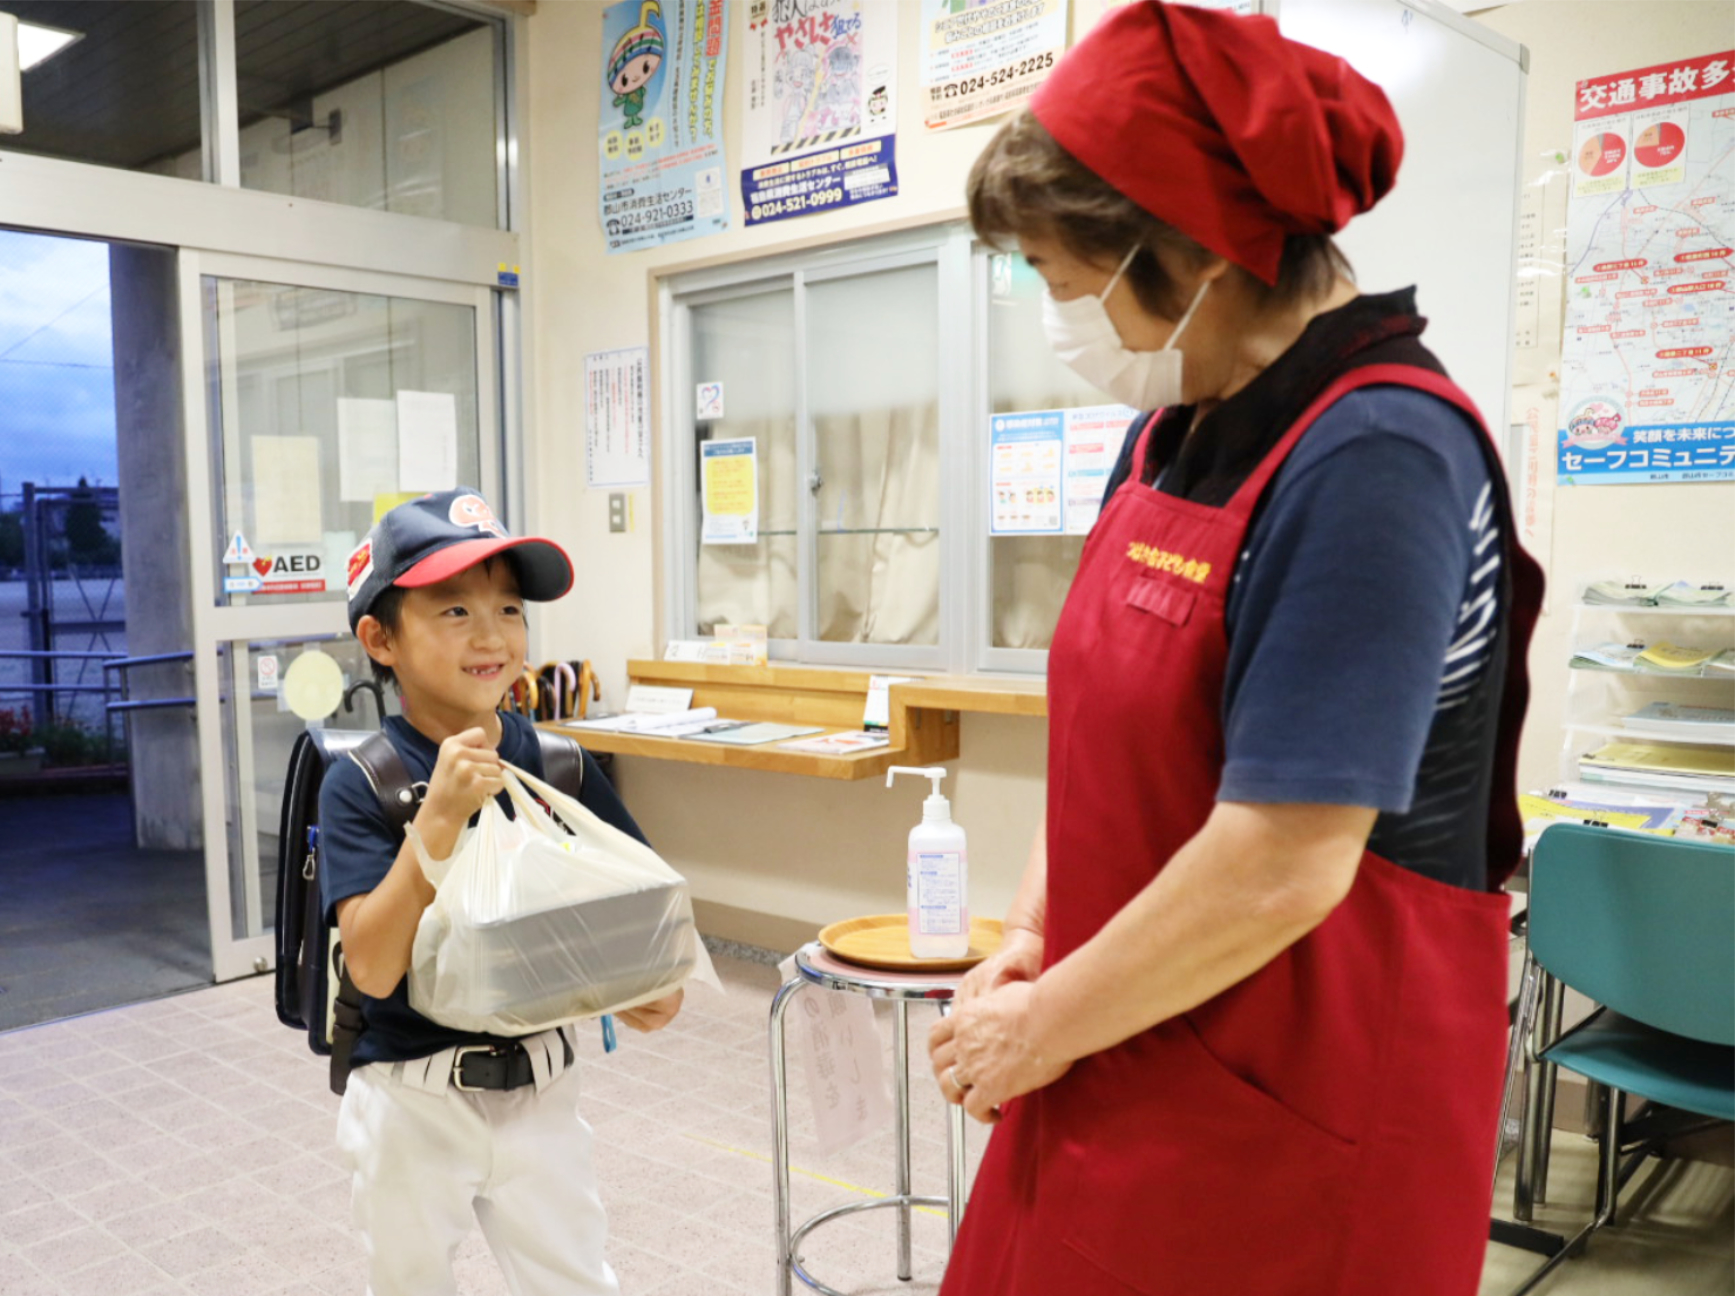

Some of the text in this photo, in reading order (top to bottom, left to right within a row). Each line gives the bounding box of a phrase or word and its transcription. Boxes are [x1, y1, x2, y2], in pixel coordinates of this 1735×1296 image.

[960, 52, 1054, 95] 024-524-2225
[1579, 59, 1735, 112] 交通事故多
[621, 200, 694, 227] 024-921-0333
[762, 188, 843, 217] 024-521-0999
[1633, 426, 1735, 444] 笑顔を未来につ
[273, 555, 321, 573] AED
